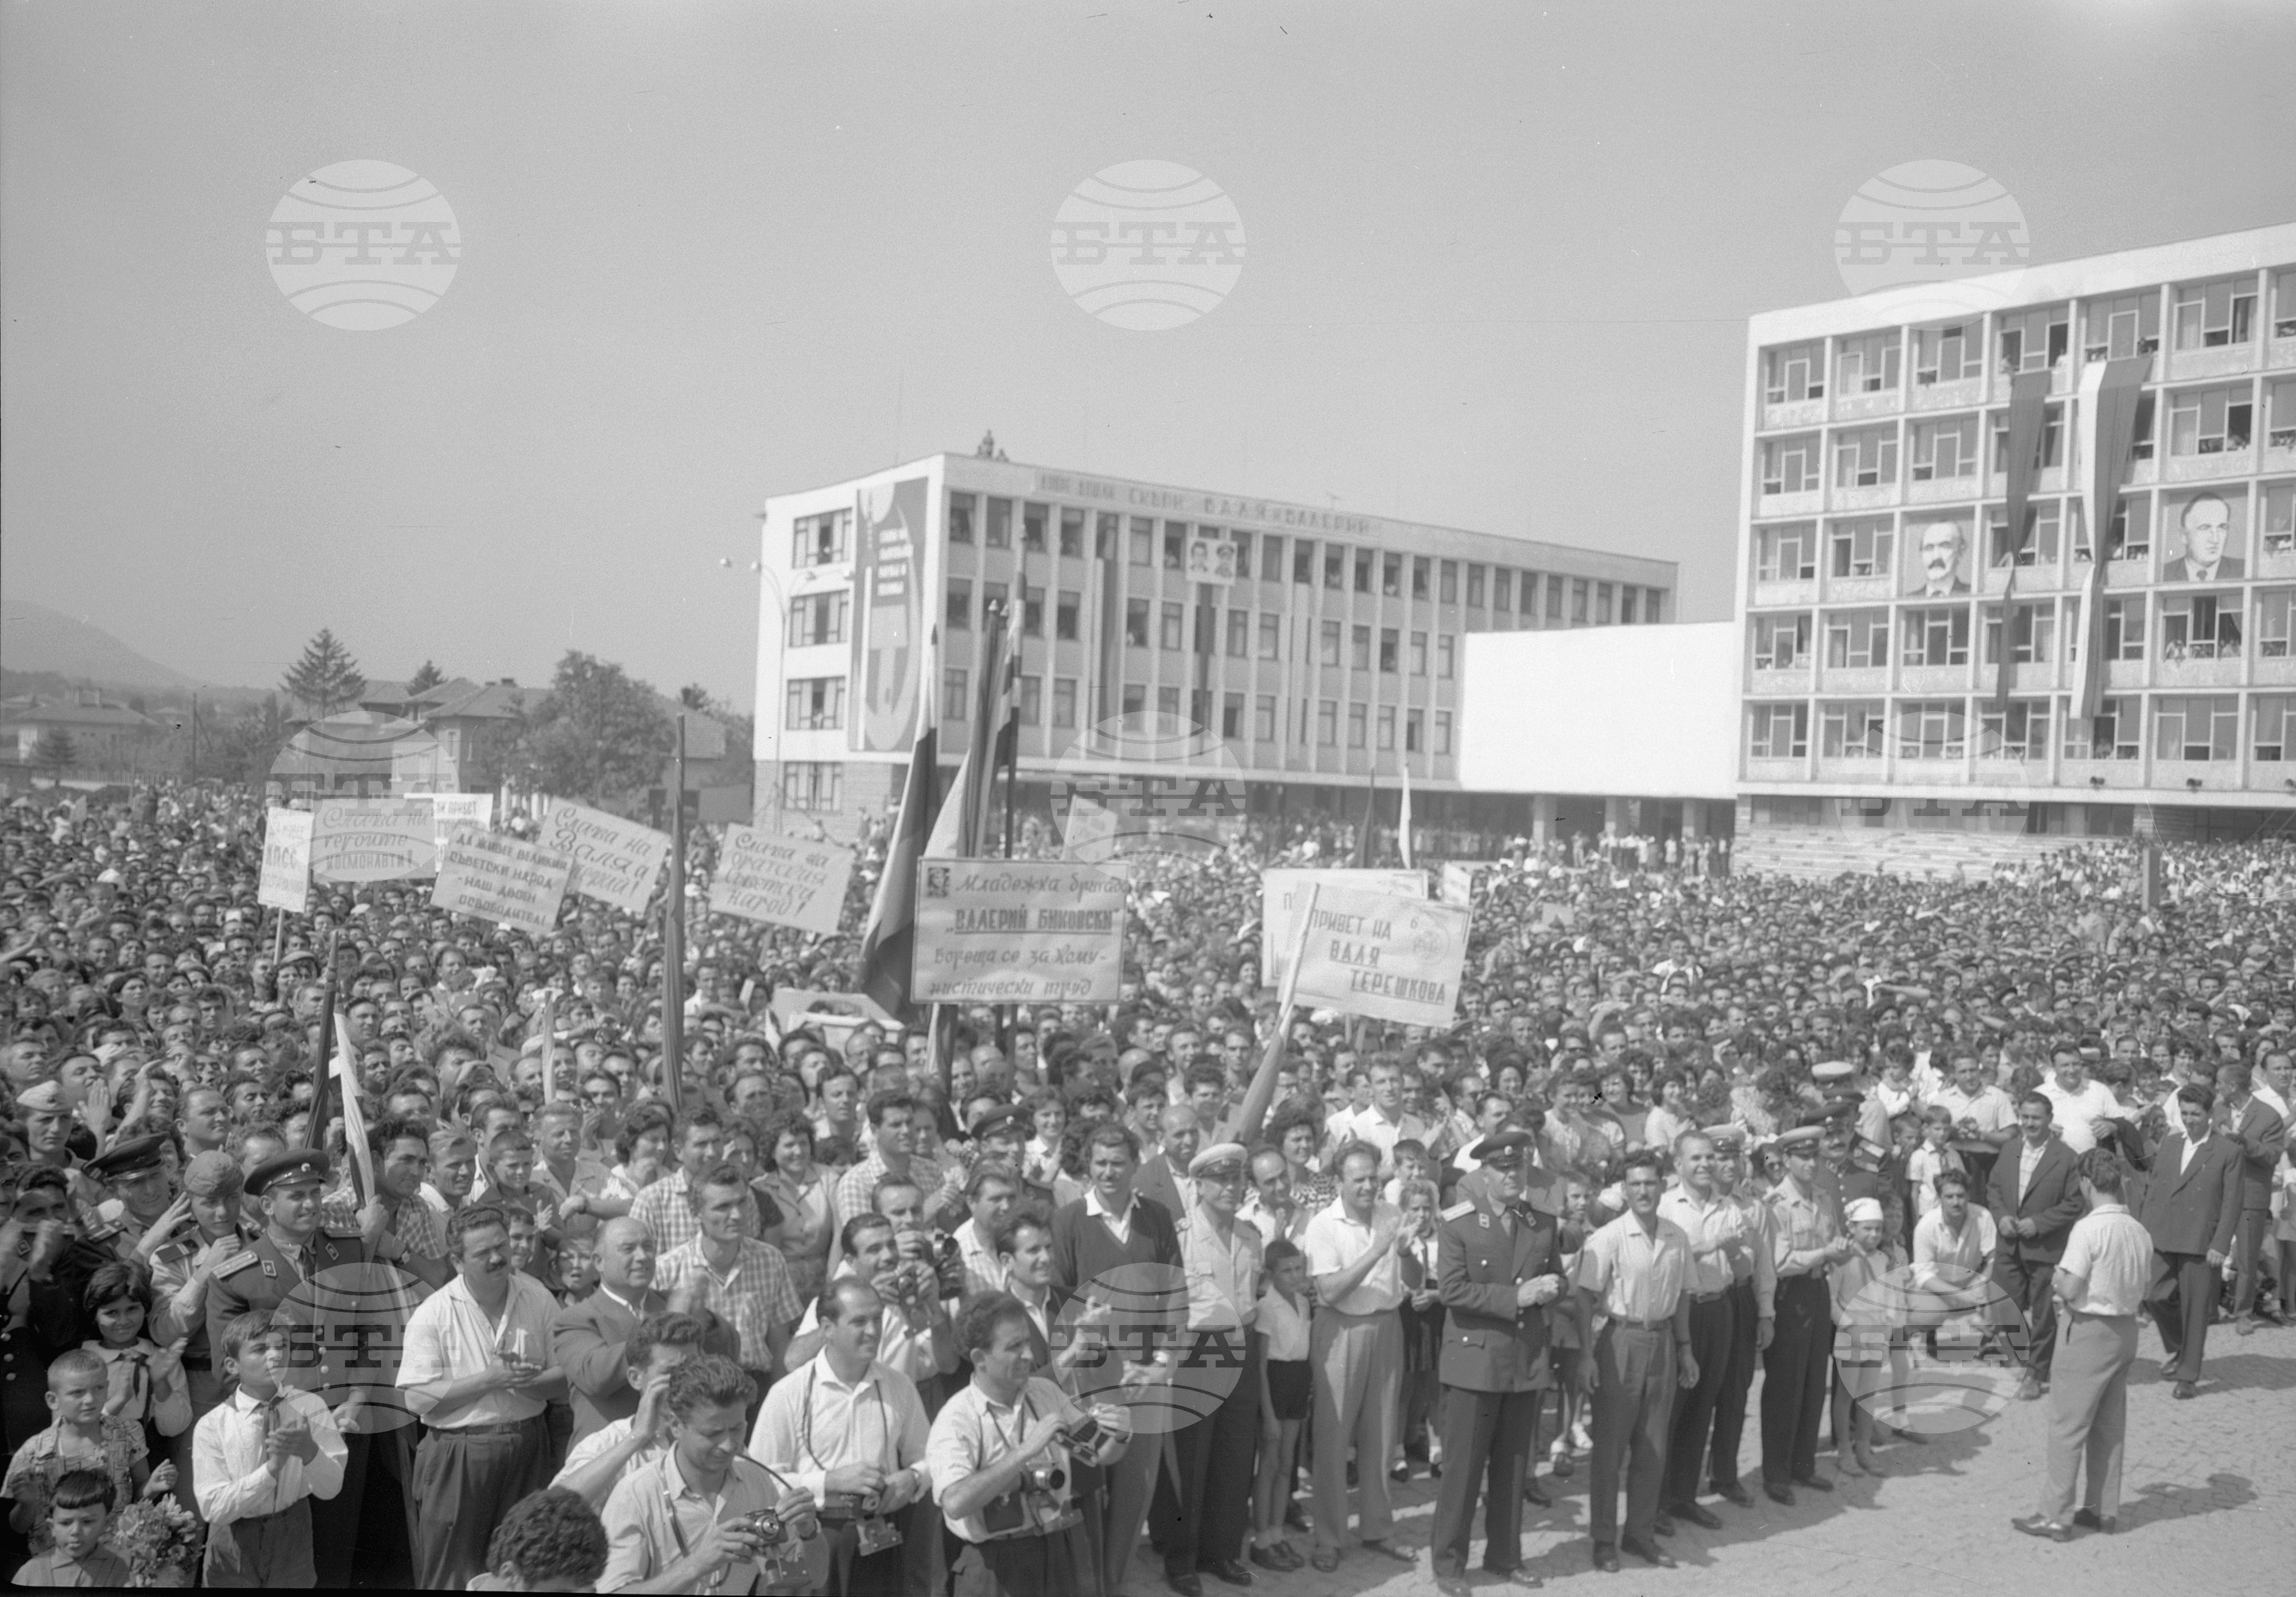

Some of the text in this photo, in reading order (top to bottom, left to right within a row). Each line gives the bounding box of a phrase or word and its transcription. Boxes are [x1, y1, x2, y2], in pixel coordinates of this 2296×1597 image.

[513, 868, 553, 891] НАРОД
[1311, 908, 1366, 935] ПРИВЕТ
[1372, 918, 1392, 941] НА
[1329, 939, 1381, 967] ВАЛЯ
[1350, 969, 1446, 1006] ТЕРЕШКОВА
